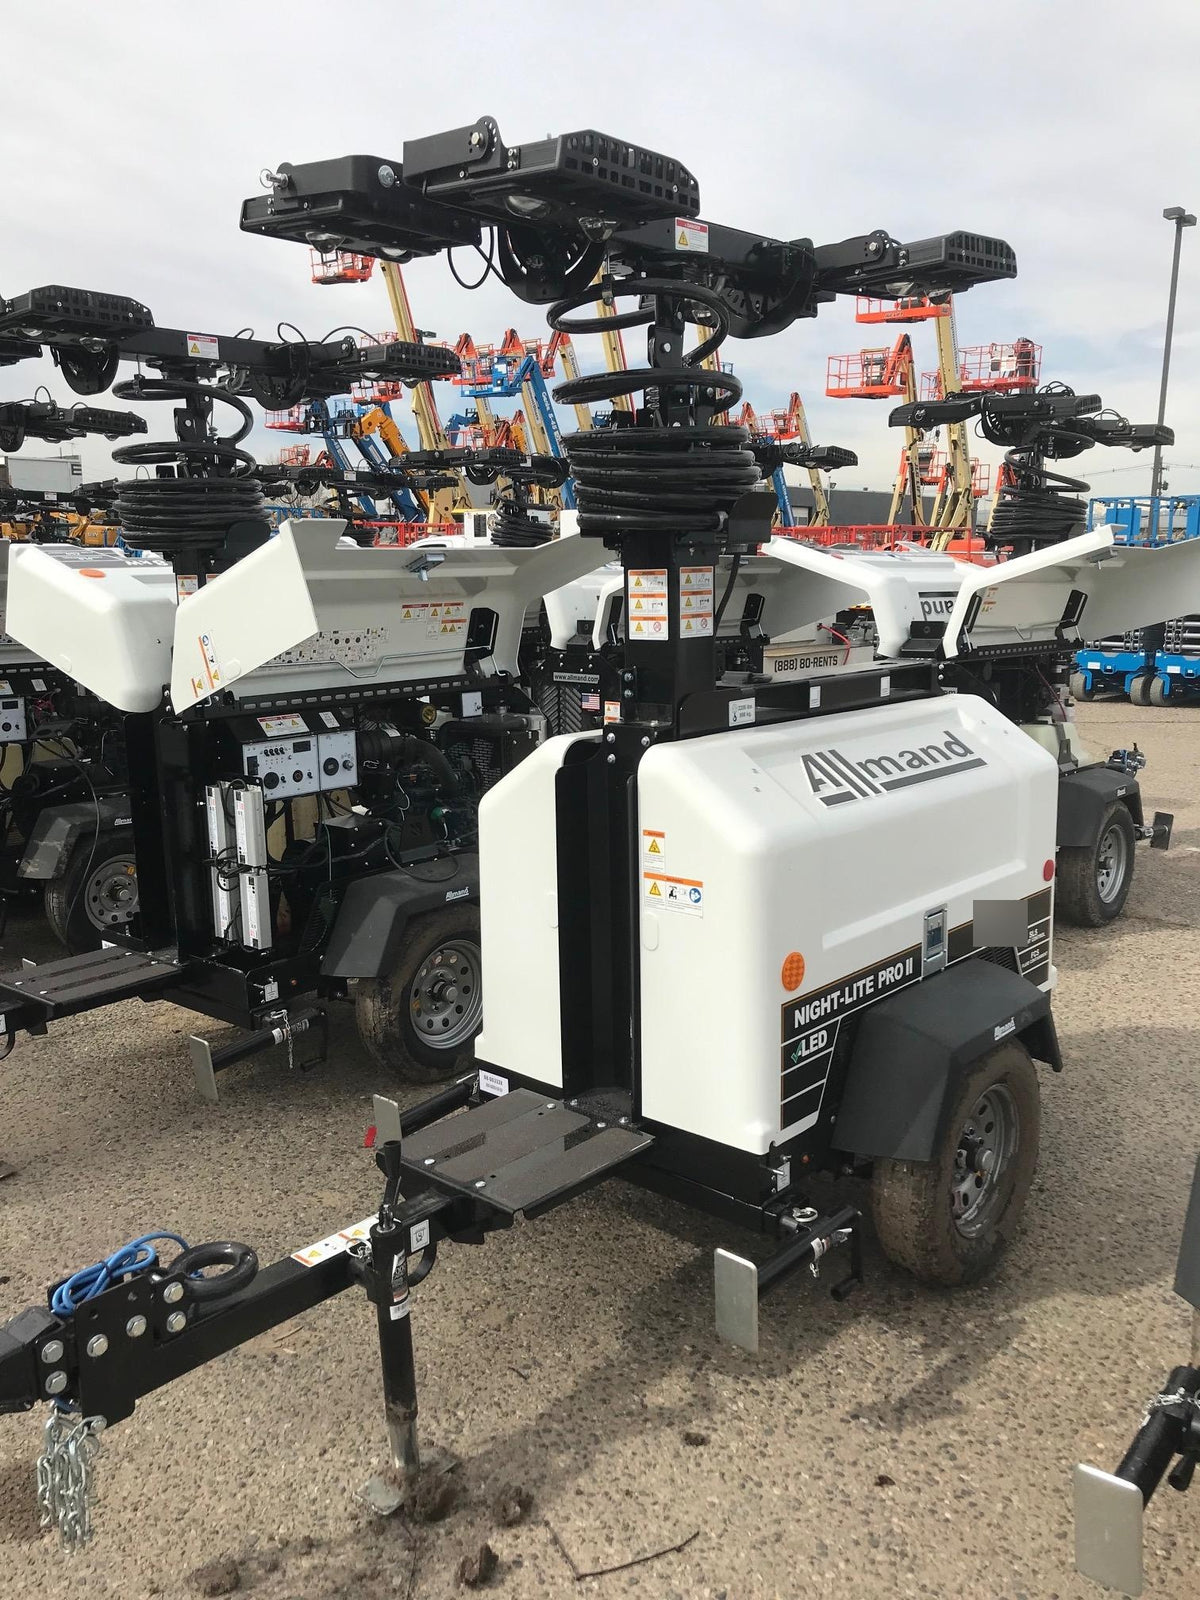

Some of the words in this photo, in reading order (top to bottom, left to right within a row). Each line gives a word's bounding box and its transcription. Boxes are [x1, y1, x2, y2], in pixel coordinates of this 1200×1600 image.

[774, 659, 798, 673] (888)
[799, 655, 838, 669] 80-RENTS
[801, 730, 974, 798] Allmand
[794, 974, 875, 1029] NIGHT-LITE
[877, 962, 904, 989] PRO
[905, 957, 914, 976] II
